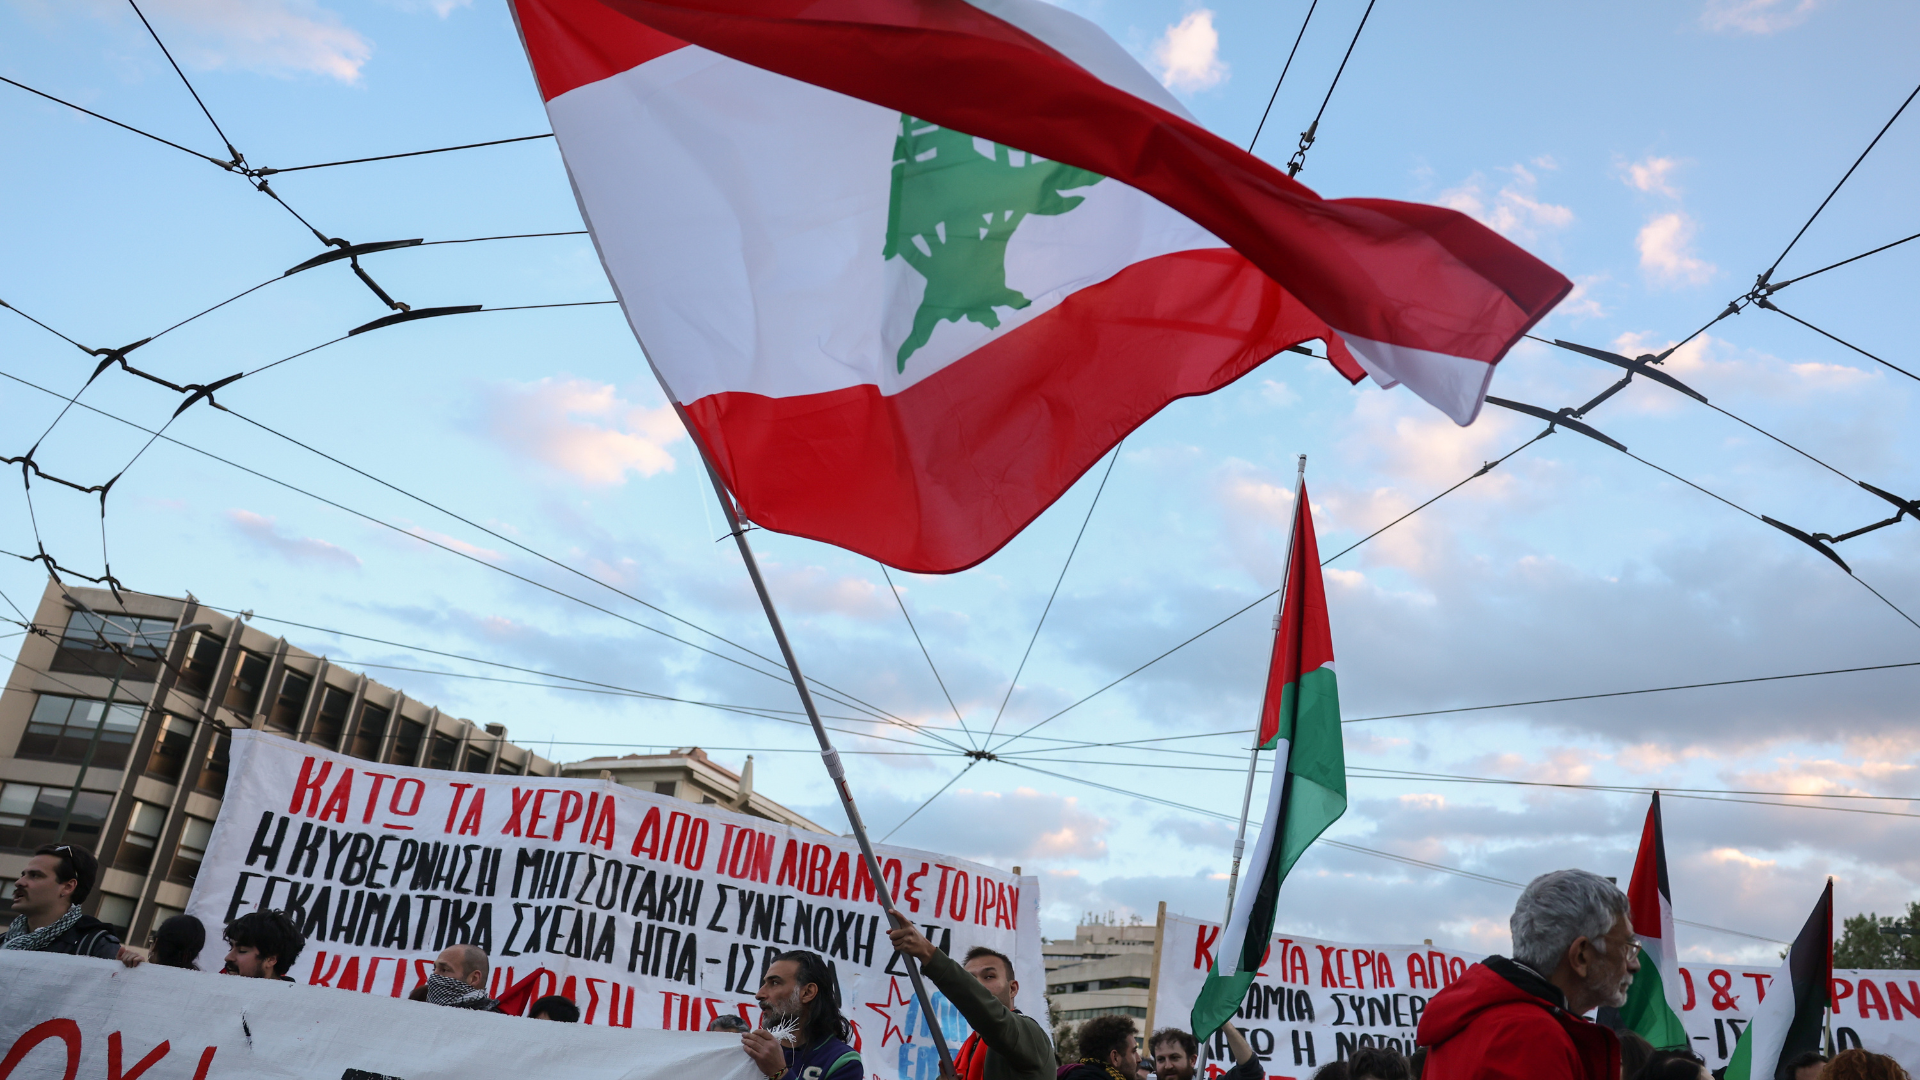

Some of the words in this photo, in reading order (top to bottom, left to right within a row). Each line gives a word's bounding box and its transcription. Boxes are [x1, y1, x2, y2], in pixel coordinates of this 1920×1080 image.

[288, 756, 426, 831] ΚΑΤΩ
[444, 782, 486, 837] ΤΑ
[501, 786, 616, 851] ΧΕΡΙΑ
[630, 806, 710, 871] ΑΠΟ
[716, 823, 776, 884] ΤΟΝ
[776, 838, 903, 907] ΛΙΒΑΝΟ
[934, 864, 969, 922] ΤΟ
[974, 875, 1020, 931] ΙΡΑΝ
[245, 811, 290, 872] Η
[285, 821, 503, 897] ΚΥΒΕΡΝΗΣΗ
[510, 847, 704, 926] ΜΗΤΣΟΤΑΚΗ
[706, 883, 879, 968] ΣΥΝΕΝΟΧΗ
[223, 871, 492, 956] ΕΓΚΛΗΜΑΤΙΚΑ
[500, 902, 616, 964] ΣΧΕΔΙΑ
[1278, 938, 1310, 986] ΤΑ
[1316, 944, 1396, 990] ΧΕΡΙΑ
[1406, 950, 1467, 989] ΑΠΟ
[1237, 982, 1316, 1024] ΑΜΙΑ
[1330, 993, 1434, 1027] ΣΥΝΕΡ
[1707, 968, 1741, 1012] &
[1742, 972, 1774, 1006] Τ
[1823, 977, 1920, 1021] ΡΑΝ
[1207, 1028, 1275, 1063] ΑΩ
[1291, 1029, 1317, 1068] Η
